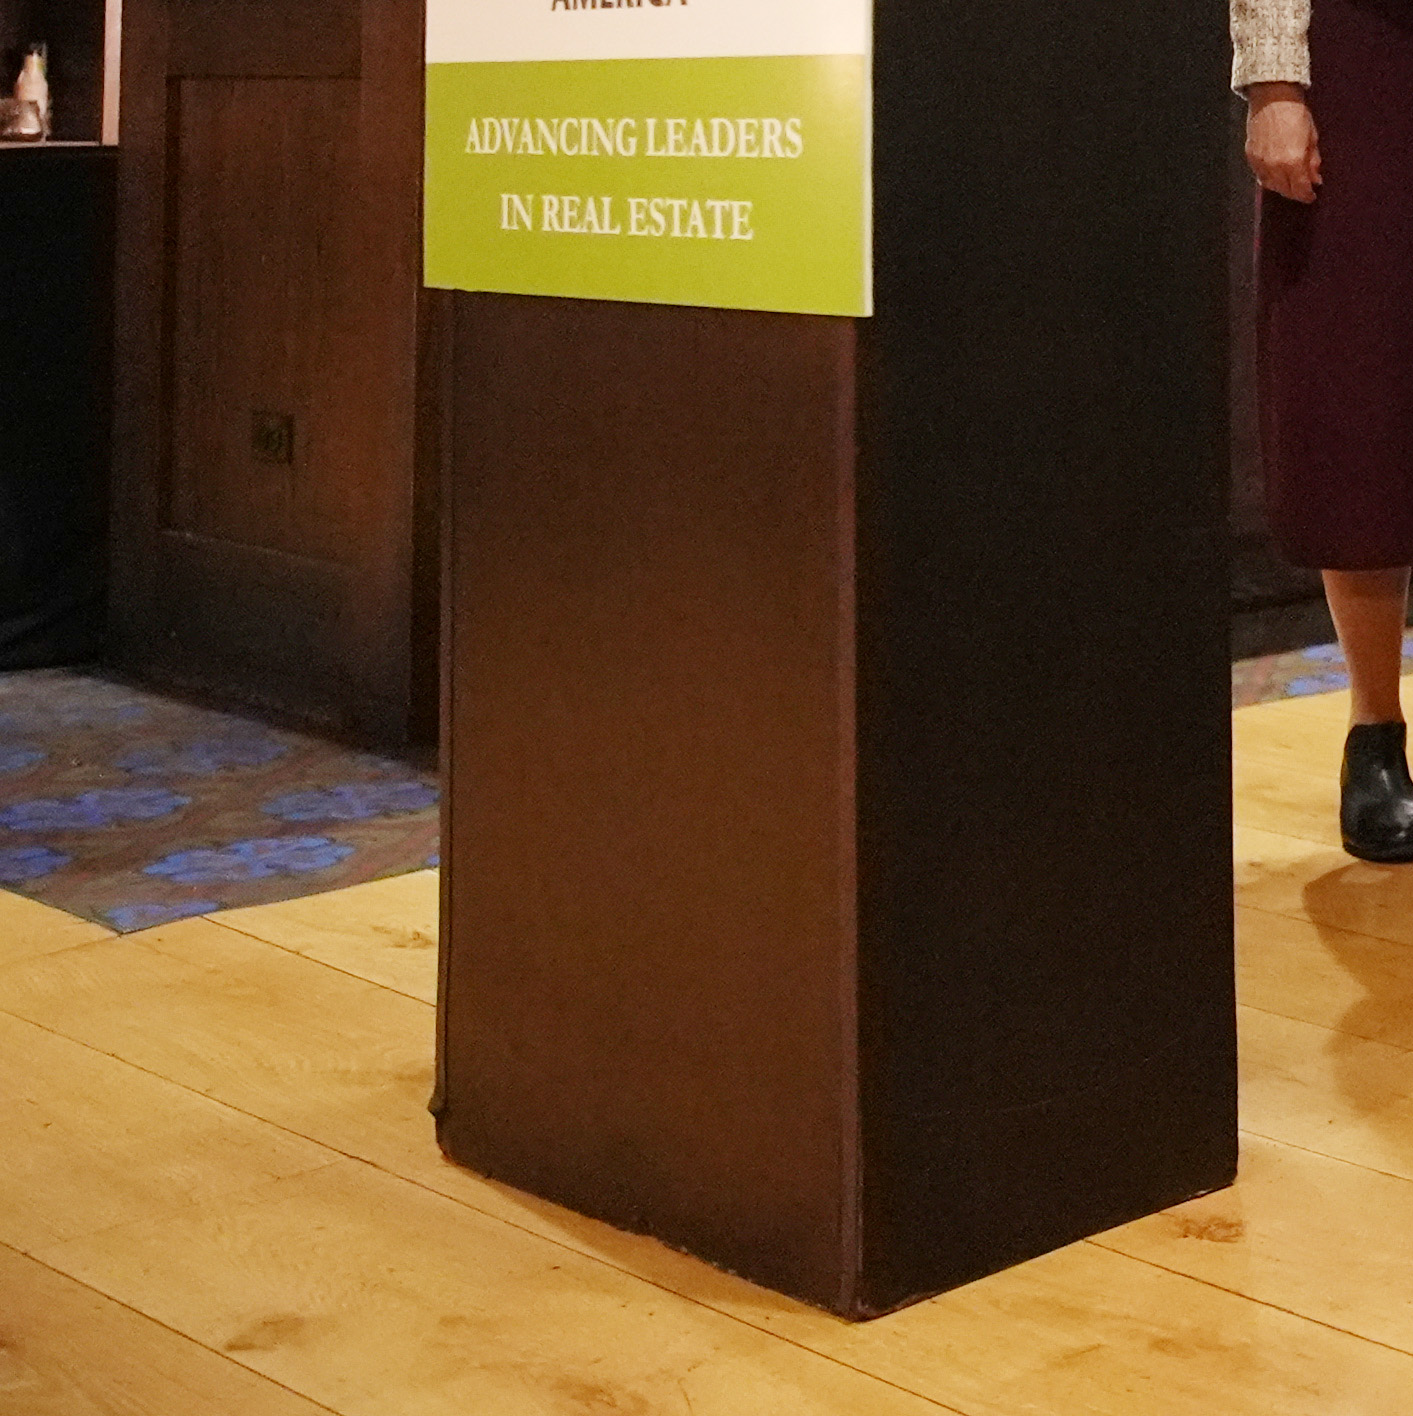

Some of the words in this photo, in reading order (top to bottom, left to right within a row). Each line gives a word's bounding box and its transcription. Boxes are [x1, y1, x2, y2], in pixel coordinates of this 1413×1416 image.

[465, 117, 638, 157] ADVANCING
[644, 117, 803, 159] LEADERS
[500, 193, 533, 231] IN
[541, 195, 621, 236] REAL
[628, 198, 754, 241] ESTATE
